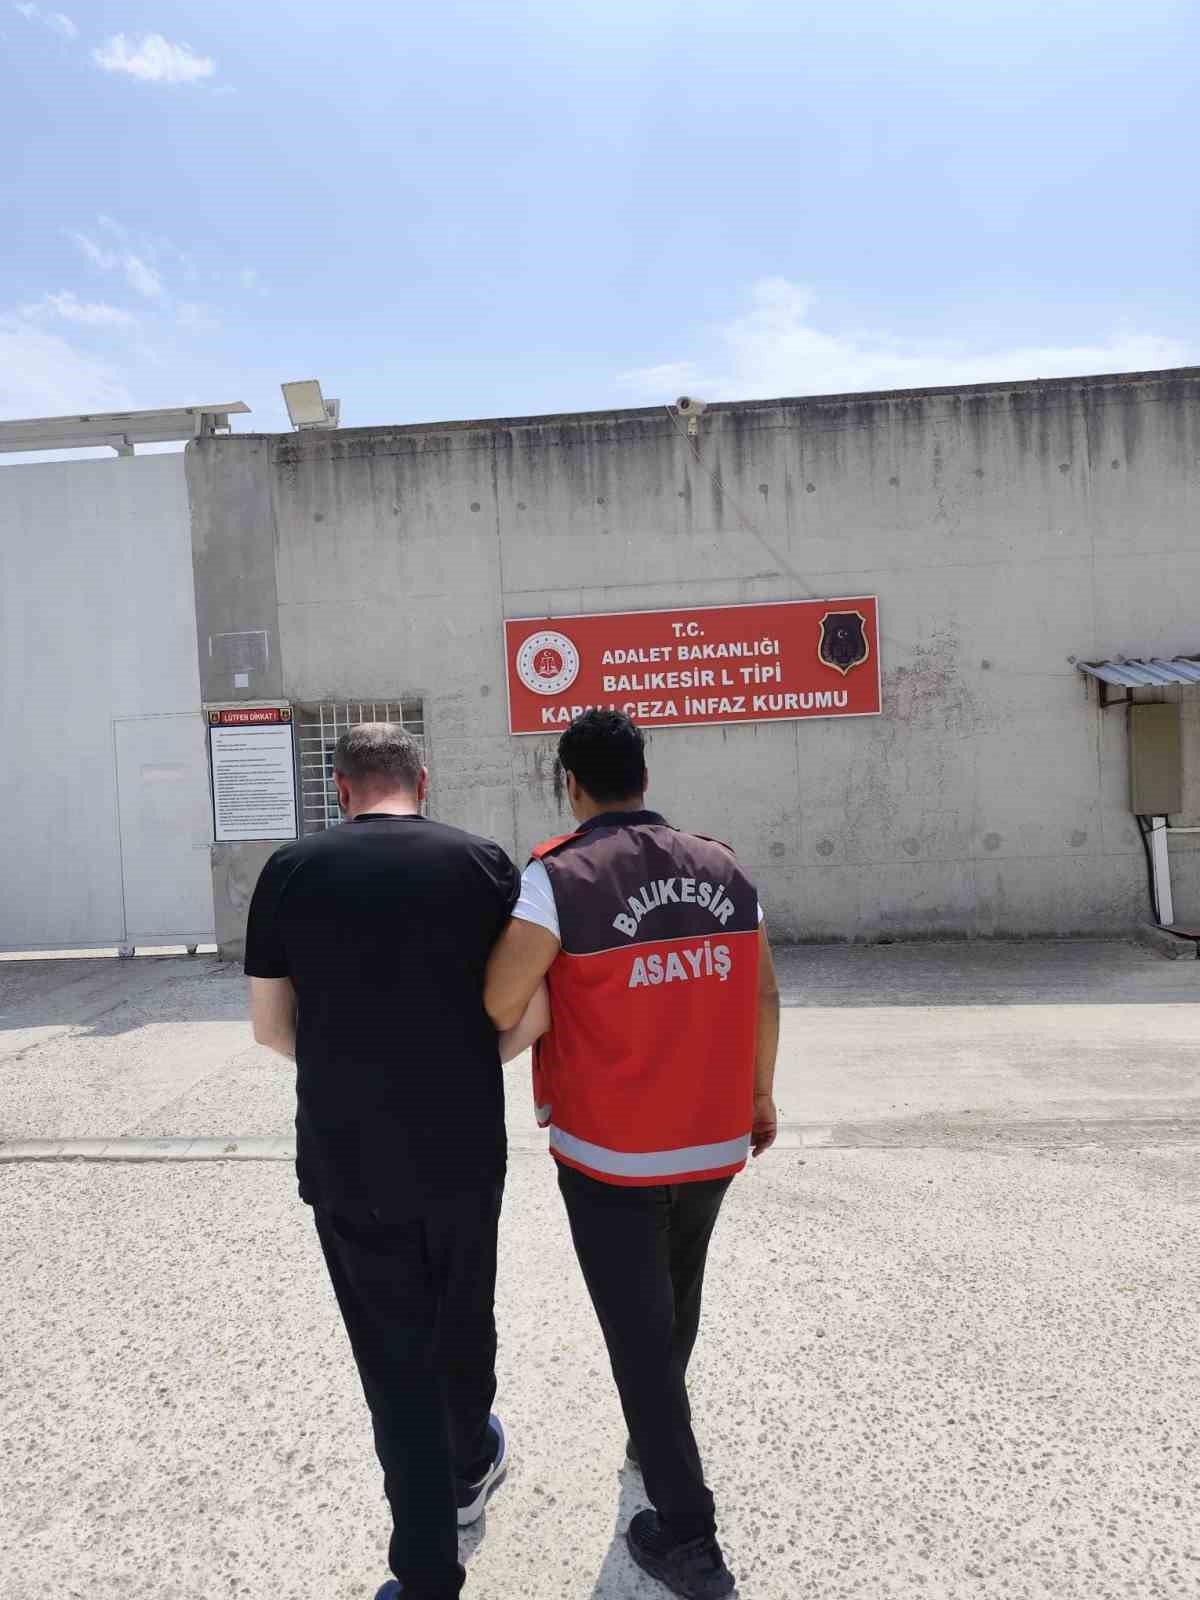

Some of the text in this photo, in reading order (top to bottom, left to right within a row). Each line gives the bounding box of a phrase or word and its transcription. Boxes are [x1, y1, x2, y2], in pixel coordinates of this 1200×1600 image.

[672, 622, 705, 638] T.C.
[601, 637, 780, 665] ADALET BAKANLIĞI
[603, 661, 782, 692] BALIKESİR L TİPİ
[623, 700, 678, 718] CEZA
[684, 696, 747, 715] İNFAZ
[752, 690, 849, 711] KURUMU
[612, 877, 735, 938] BALIKESİR
[628, 940, 732, 988] ASAYİŞ
